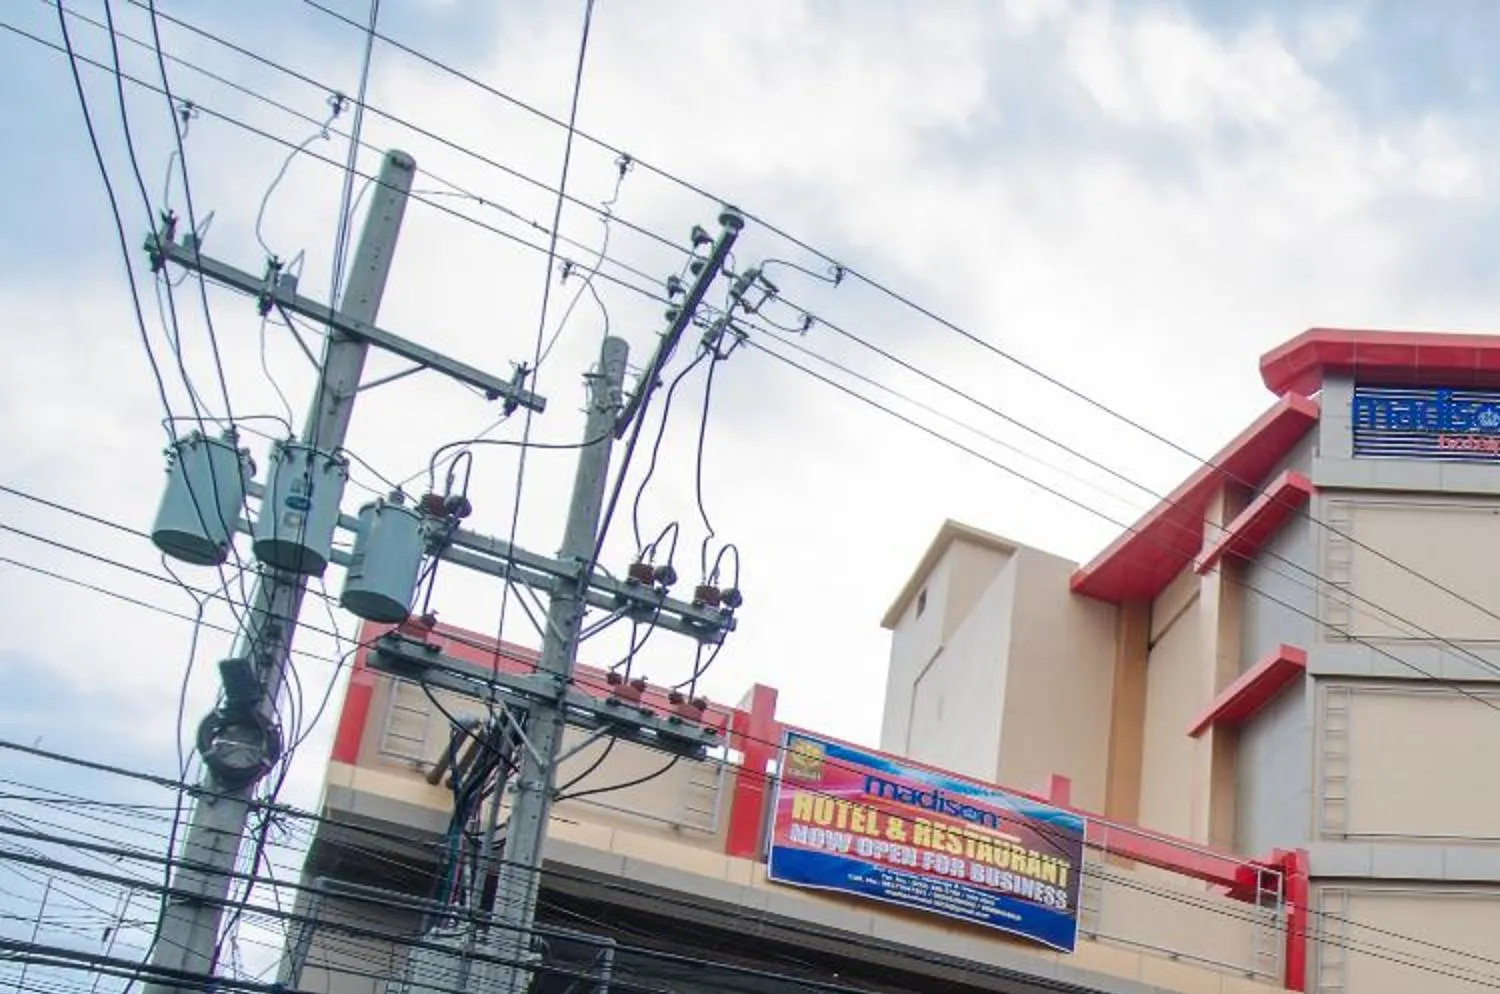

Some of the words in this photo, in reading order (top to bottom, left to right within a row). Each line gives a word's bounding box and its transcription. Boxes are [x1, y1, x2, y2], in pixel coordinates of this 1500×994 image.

[791, 791, 881, 837] HOTEL
[885, 815, 908, 842] &
[913, 817, 1071, 888] RESTAURANT
[863, 774, 1000, 829] madison
[789, 823, 851, 853] NOW
[857, 835, 917, 867] OPEN
[922, 851, 966, 879] FOR
[969, 863, 1068, 909] BUSINESS
